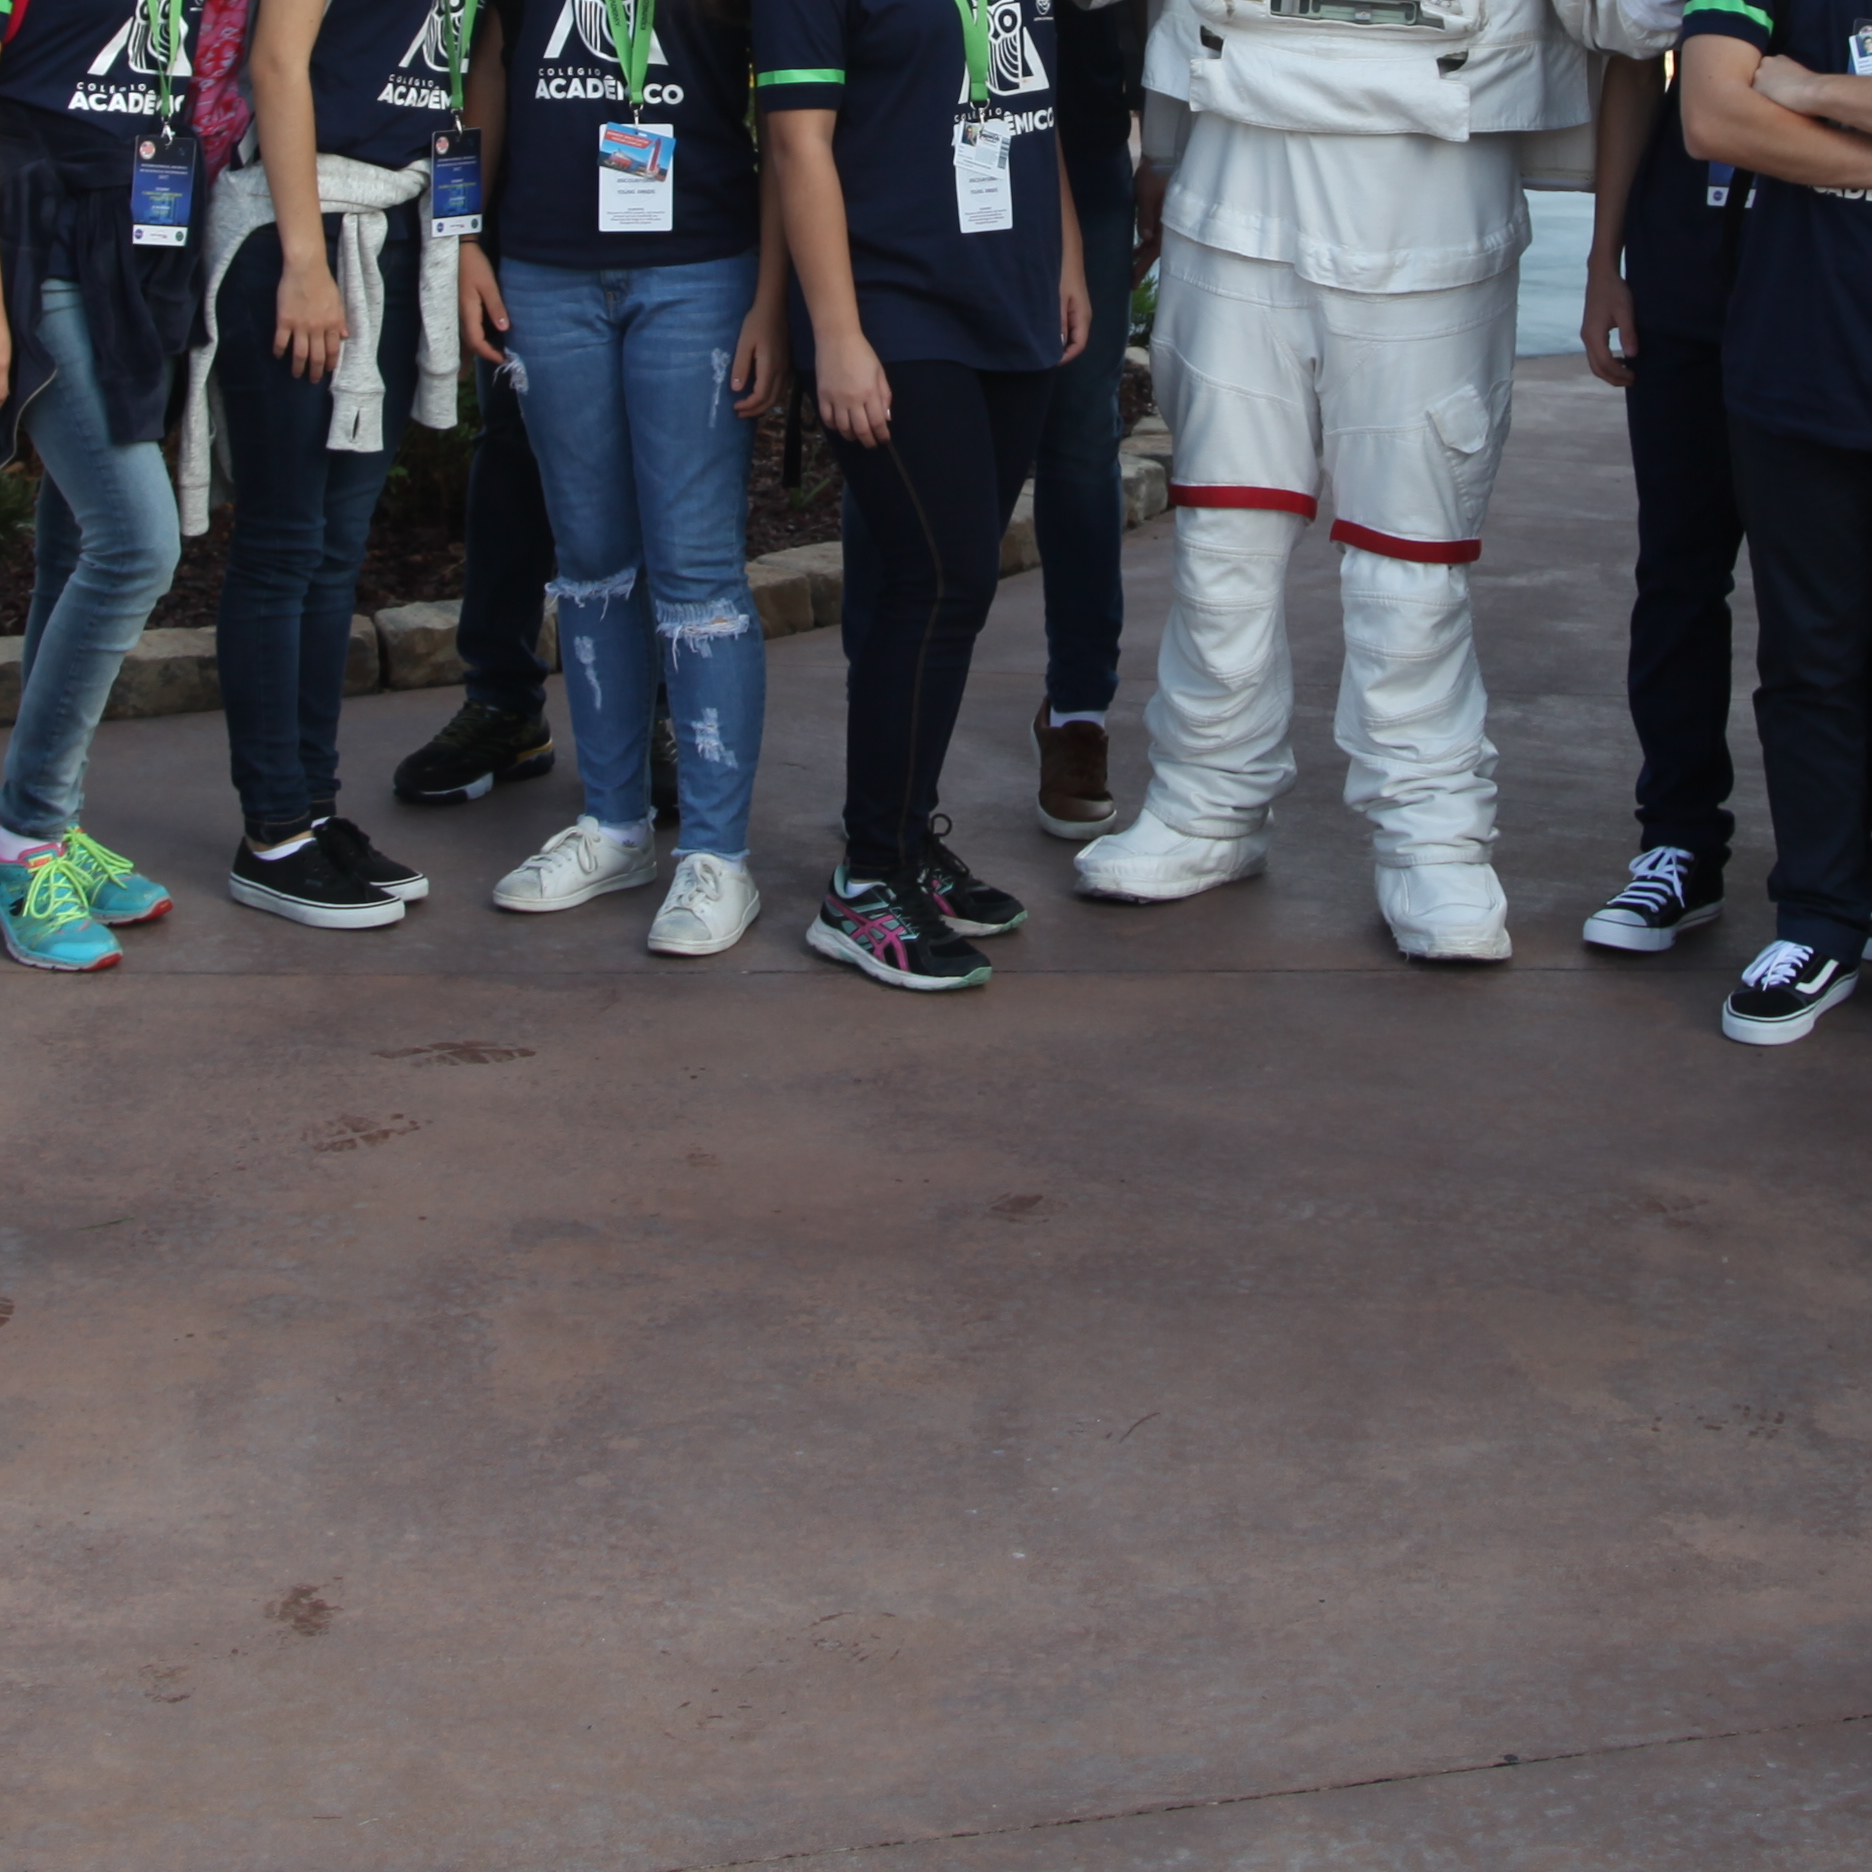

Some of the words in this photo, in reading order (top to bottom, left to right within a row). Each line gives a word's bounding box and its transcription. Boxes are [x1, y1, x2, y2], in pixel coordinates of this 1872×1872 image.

[538, 65, 601, 78] COLÉGIO
[376, 82, 453, 111] ACADÊM
[535, 73, 685, 106] ACADÊCO
